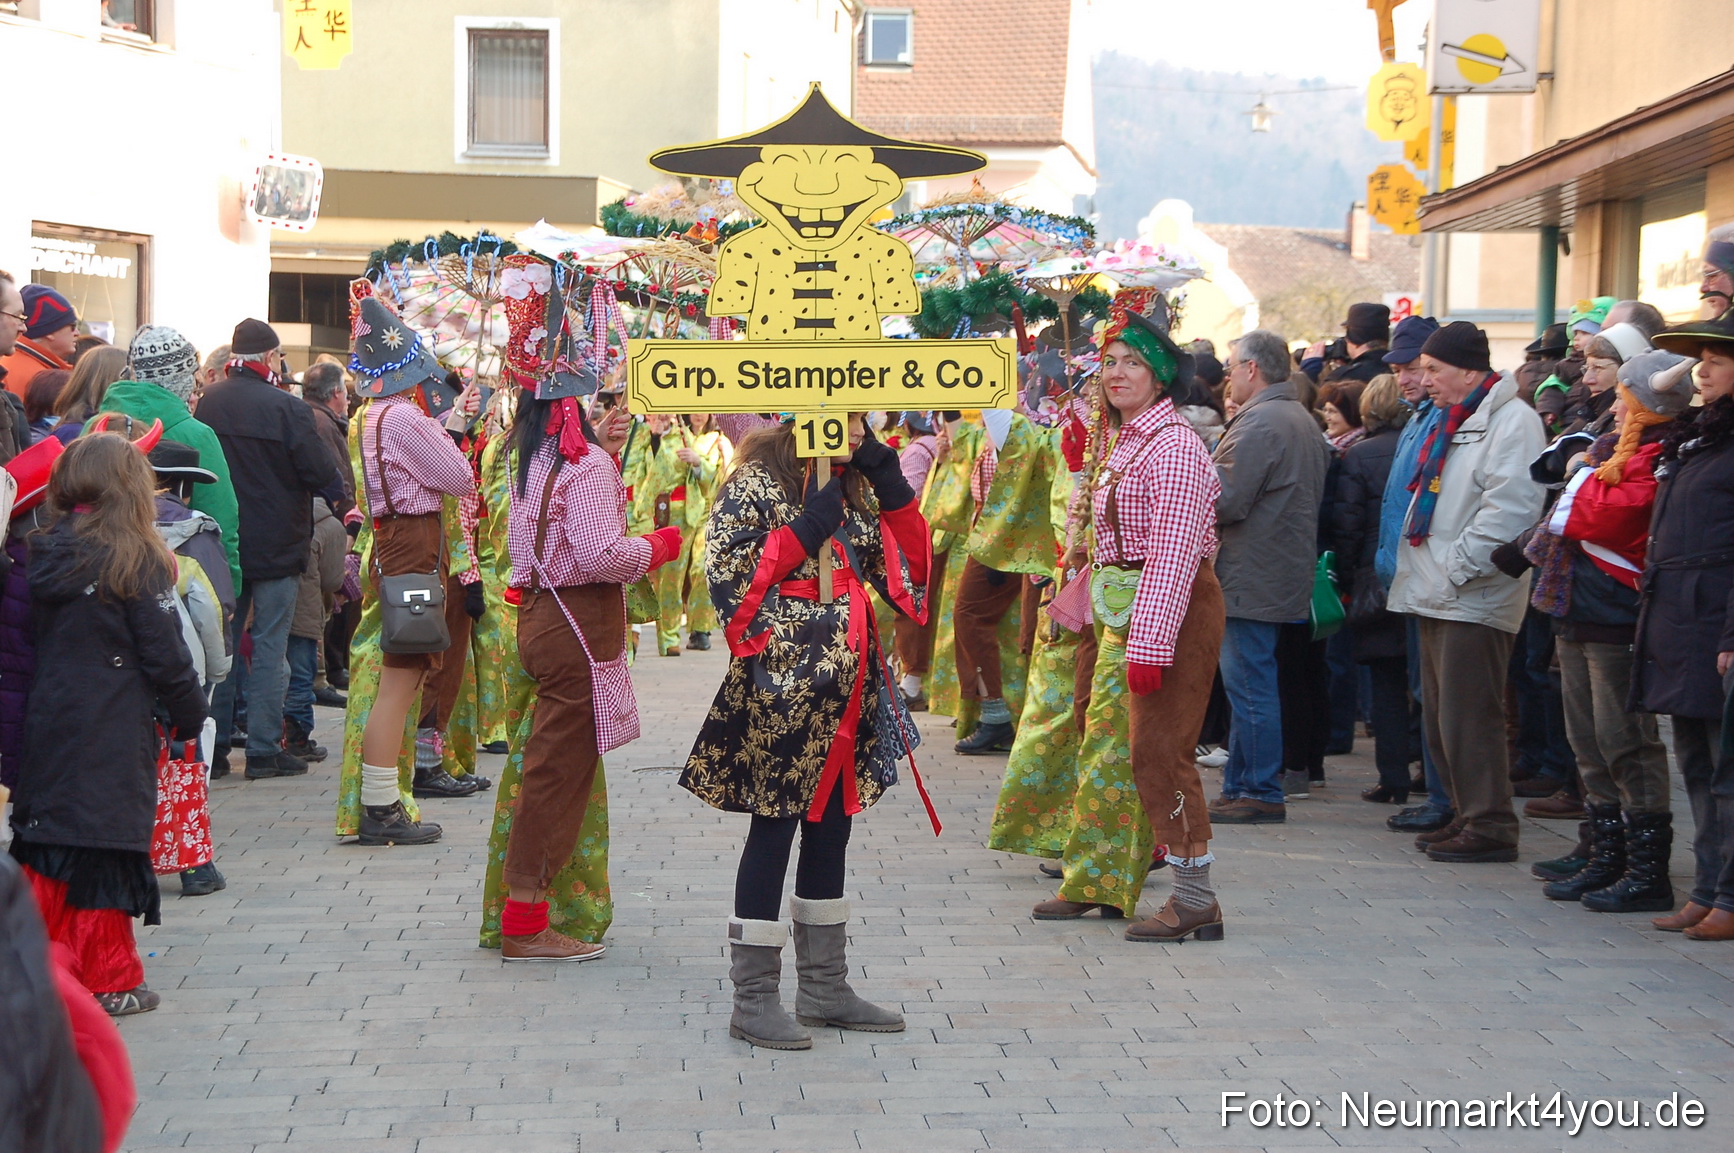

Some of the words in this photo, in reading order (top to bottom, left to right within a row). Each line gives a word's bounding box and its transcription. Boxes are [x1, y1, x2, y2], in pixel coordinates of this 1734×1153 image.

[650, 359, 724, 396] Grp.
[737, 359, 891, 396] Stampfer
[901, 359, 925, 389] &
[936, 359, 997, 389] Co.
[800, 418, 844, 451] 19
